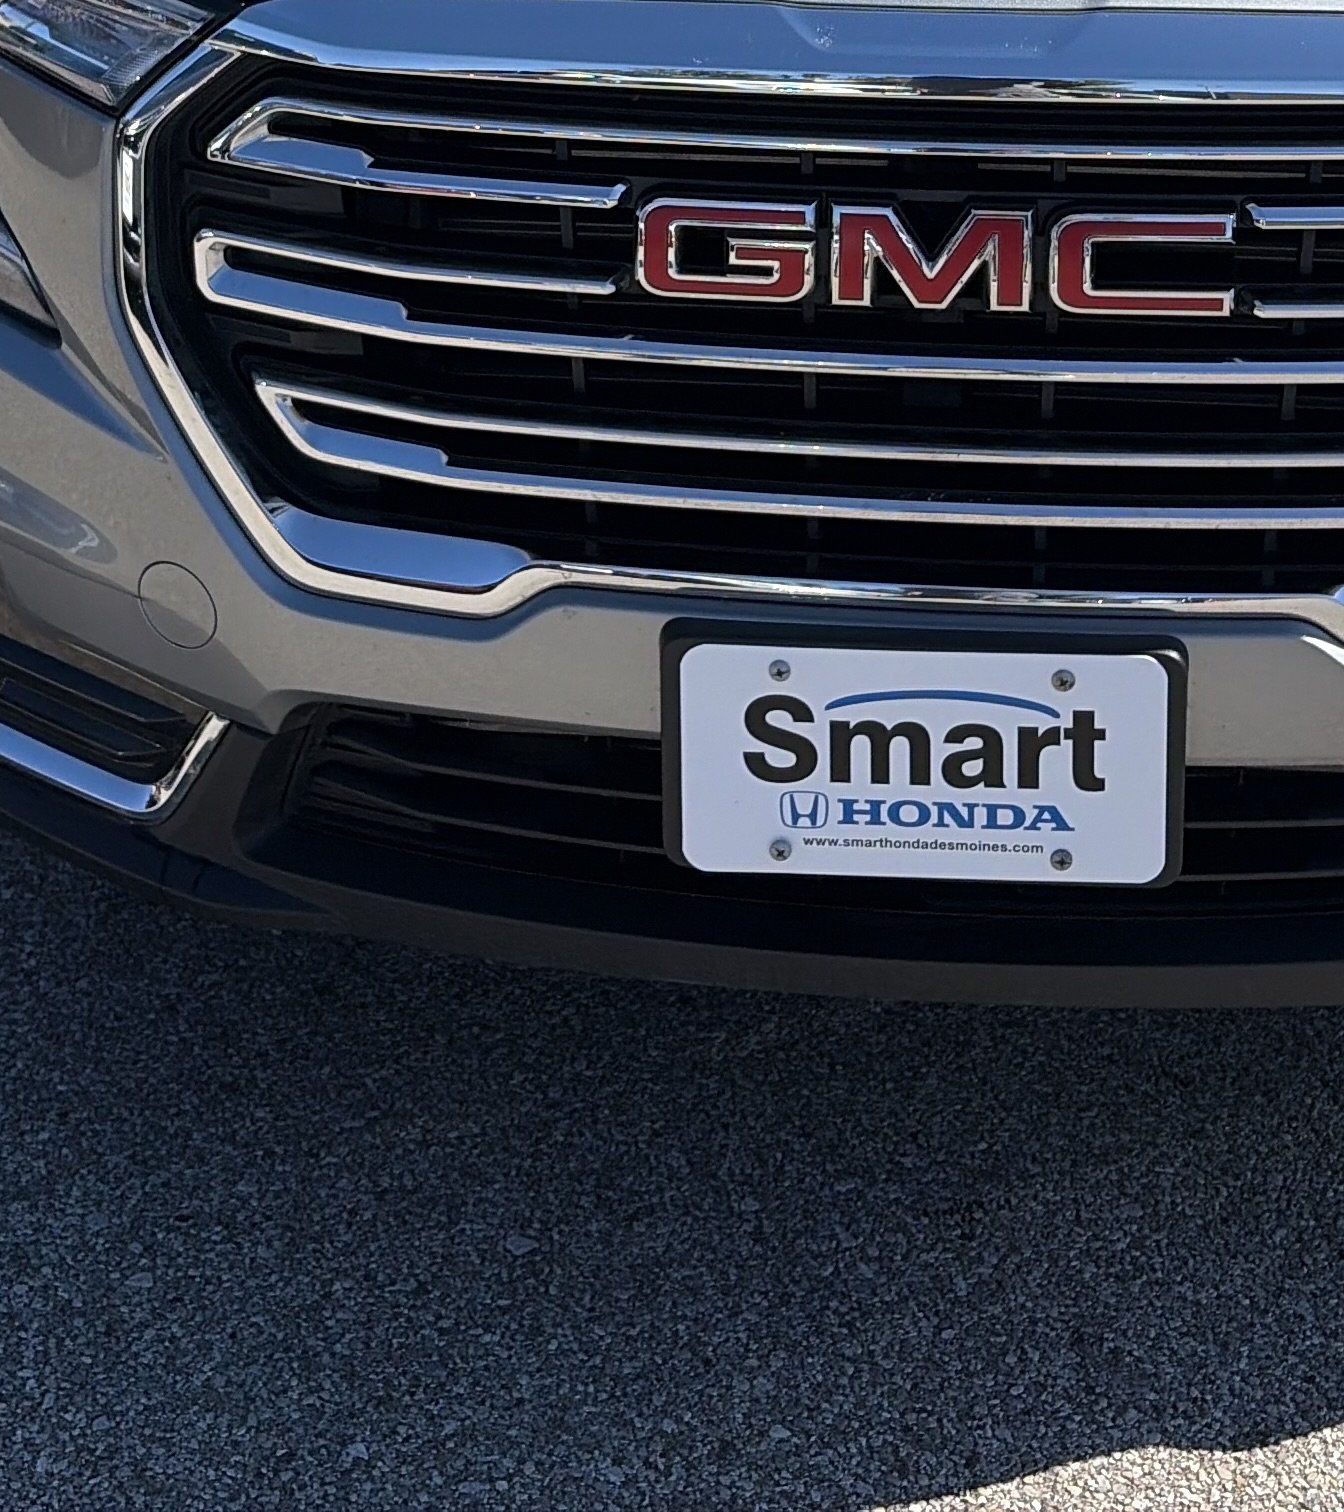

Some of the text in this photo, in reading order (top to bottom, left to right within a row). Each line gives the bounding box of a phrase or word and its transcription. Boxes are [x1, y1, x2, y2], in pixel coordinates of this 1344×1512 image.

[636, 197, 1235, 317] GMC
[742, 694, 1106, 791] Smart
[803, 836, 1044, 854] www.smarthondadesmoines.com
[837, 798, 1074, 831] HONDA
